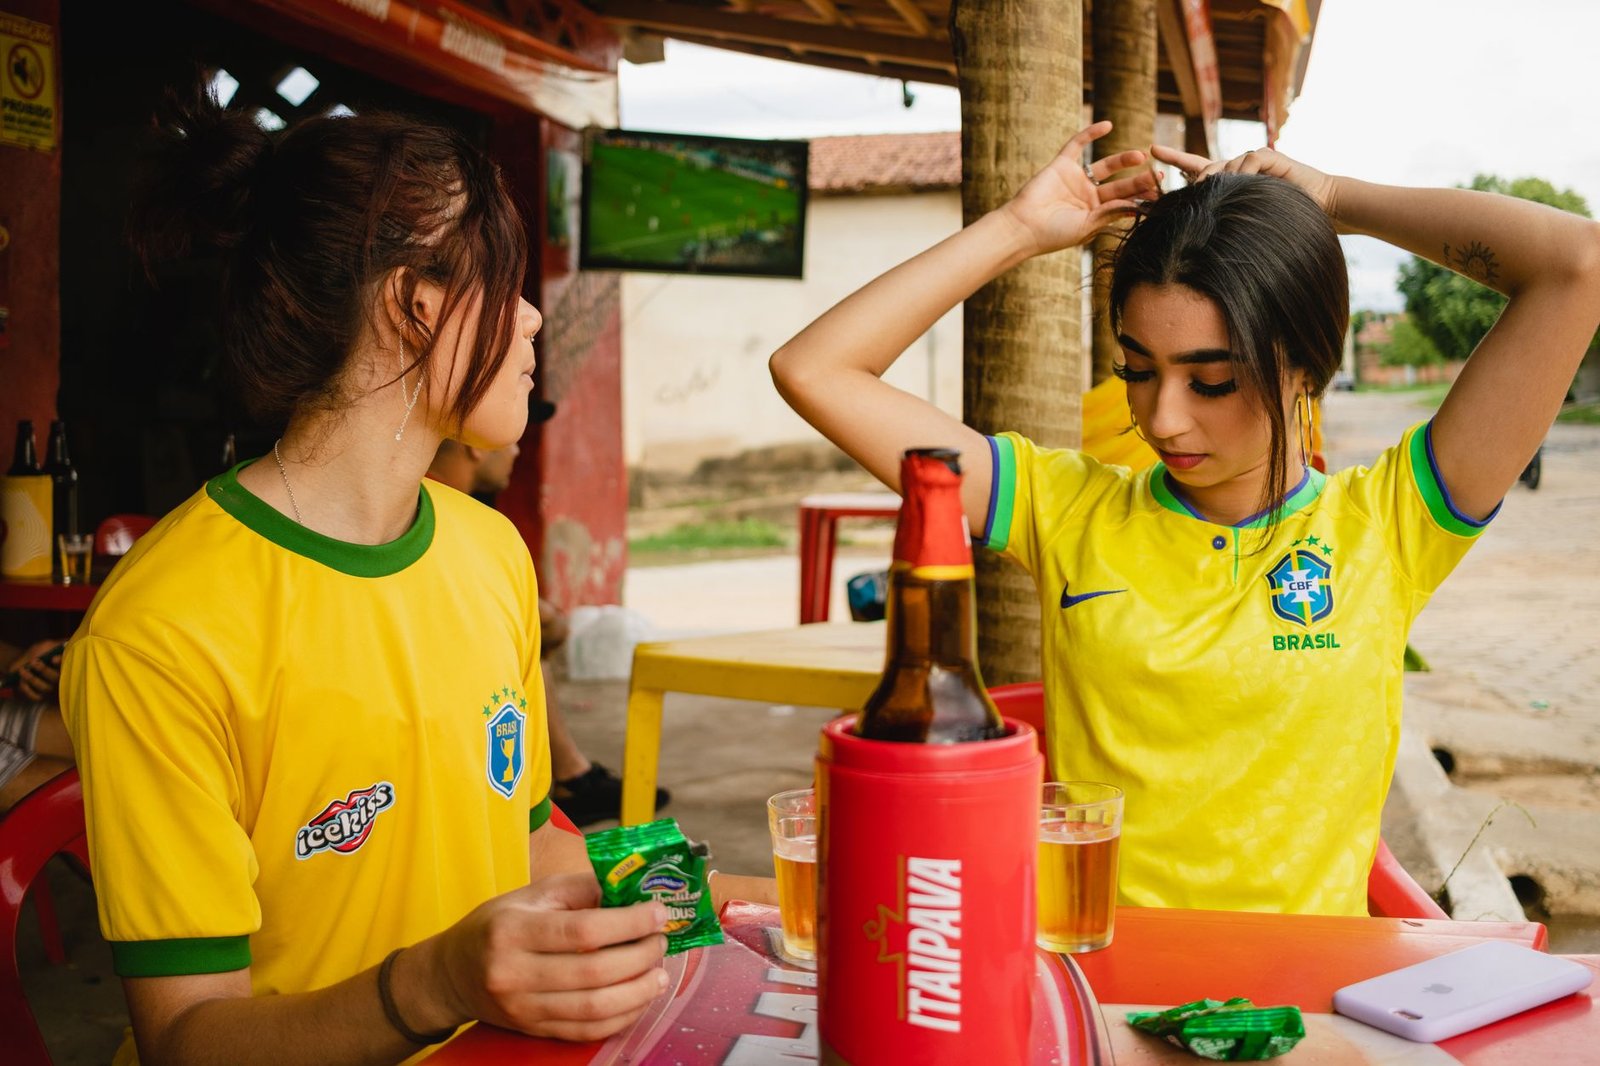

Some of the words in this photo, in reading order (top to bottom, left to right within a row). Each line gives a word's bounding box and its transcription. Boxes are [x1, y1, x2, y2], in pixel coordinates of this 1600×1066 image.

[1288, 581, 1313, 591] CBF
[1272, 633, 1341, 651] BRASIL
[297, 784, 393, 857] icekiss
[907, 856, 962, 1033] ITAIPAVA
